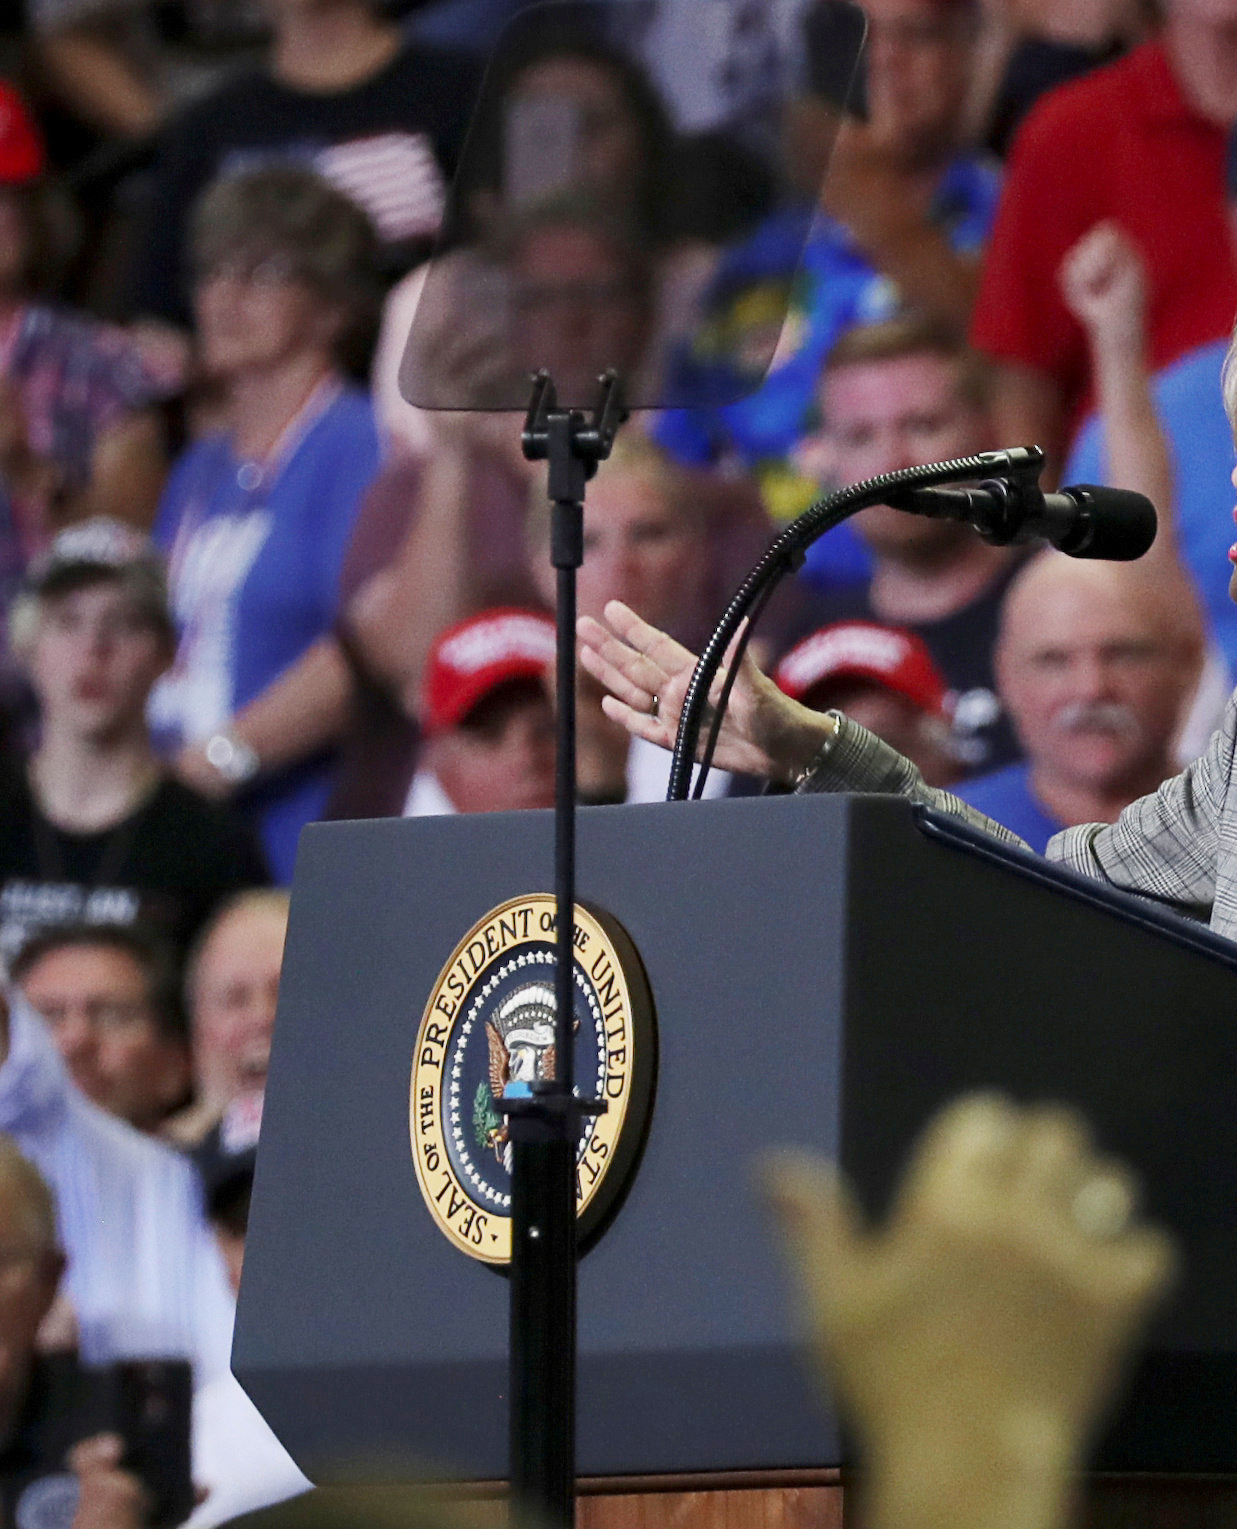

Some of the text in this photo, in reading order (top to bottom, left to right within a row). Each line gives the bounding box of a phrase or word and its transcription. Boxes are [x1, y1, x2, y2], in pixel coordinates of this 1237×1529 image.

[573, 924, 590, 953] HE
[421, 908, 534, 1070] PRESIDENT
[591, 949, 626, 1099] UNITED
[420, 1085, 434, 1135] THE
[423, 1142, 440, 1172] OF
[435, 1170, 488, 1245] SEAL
